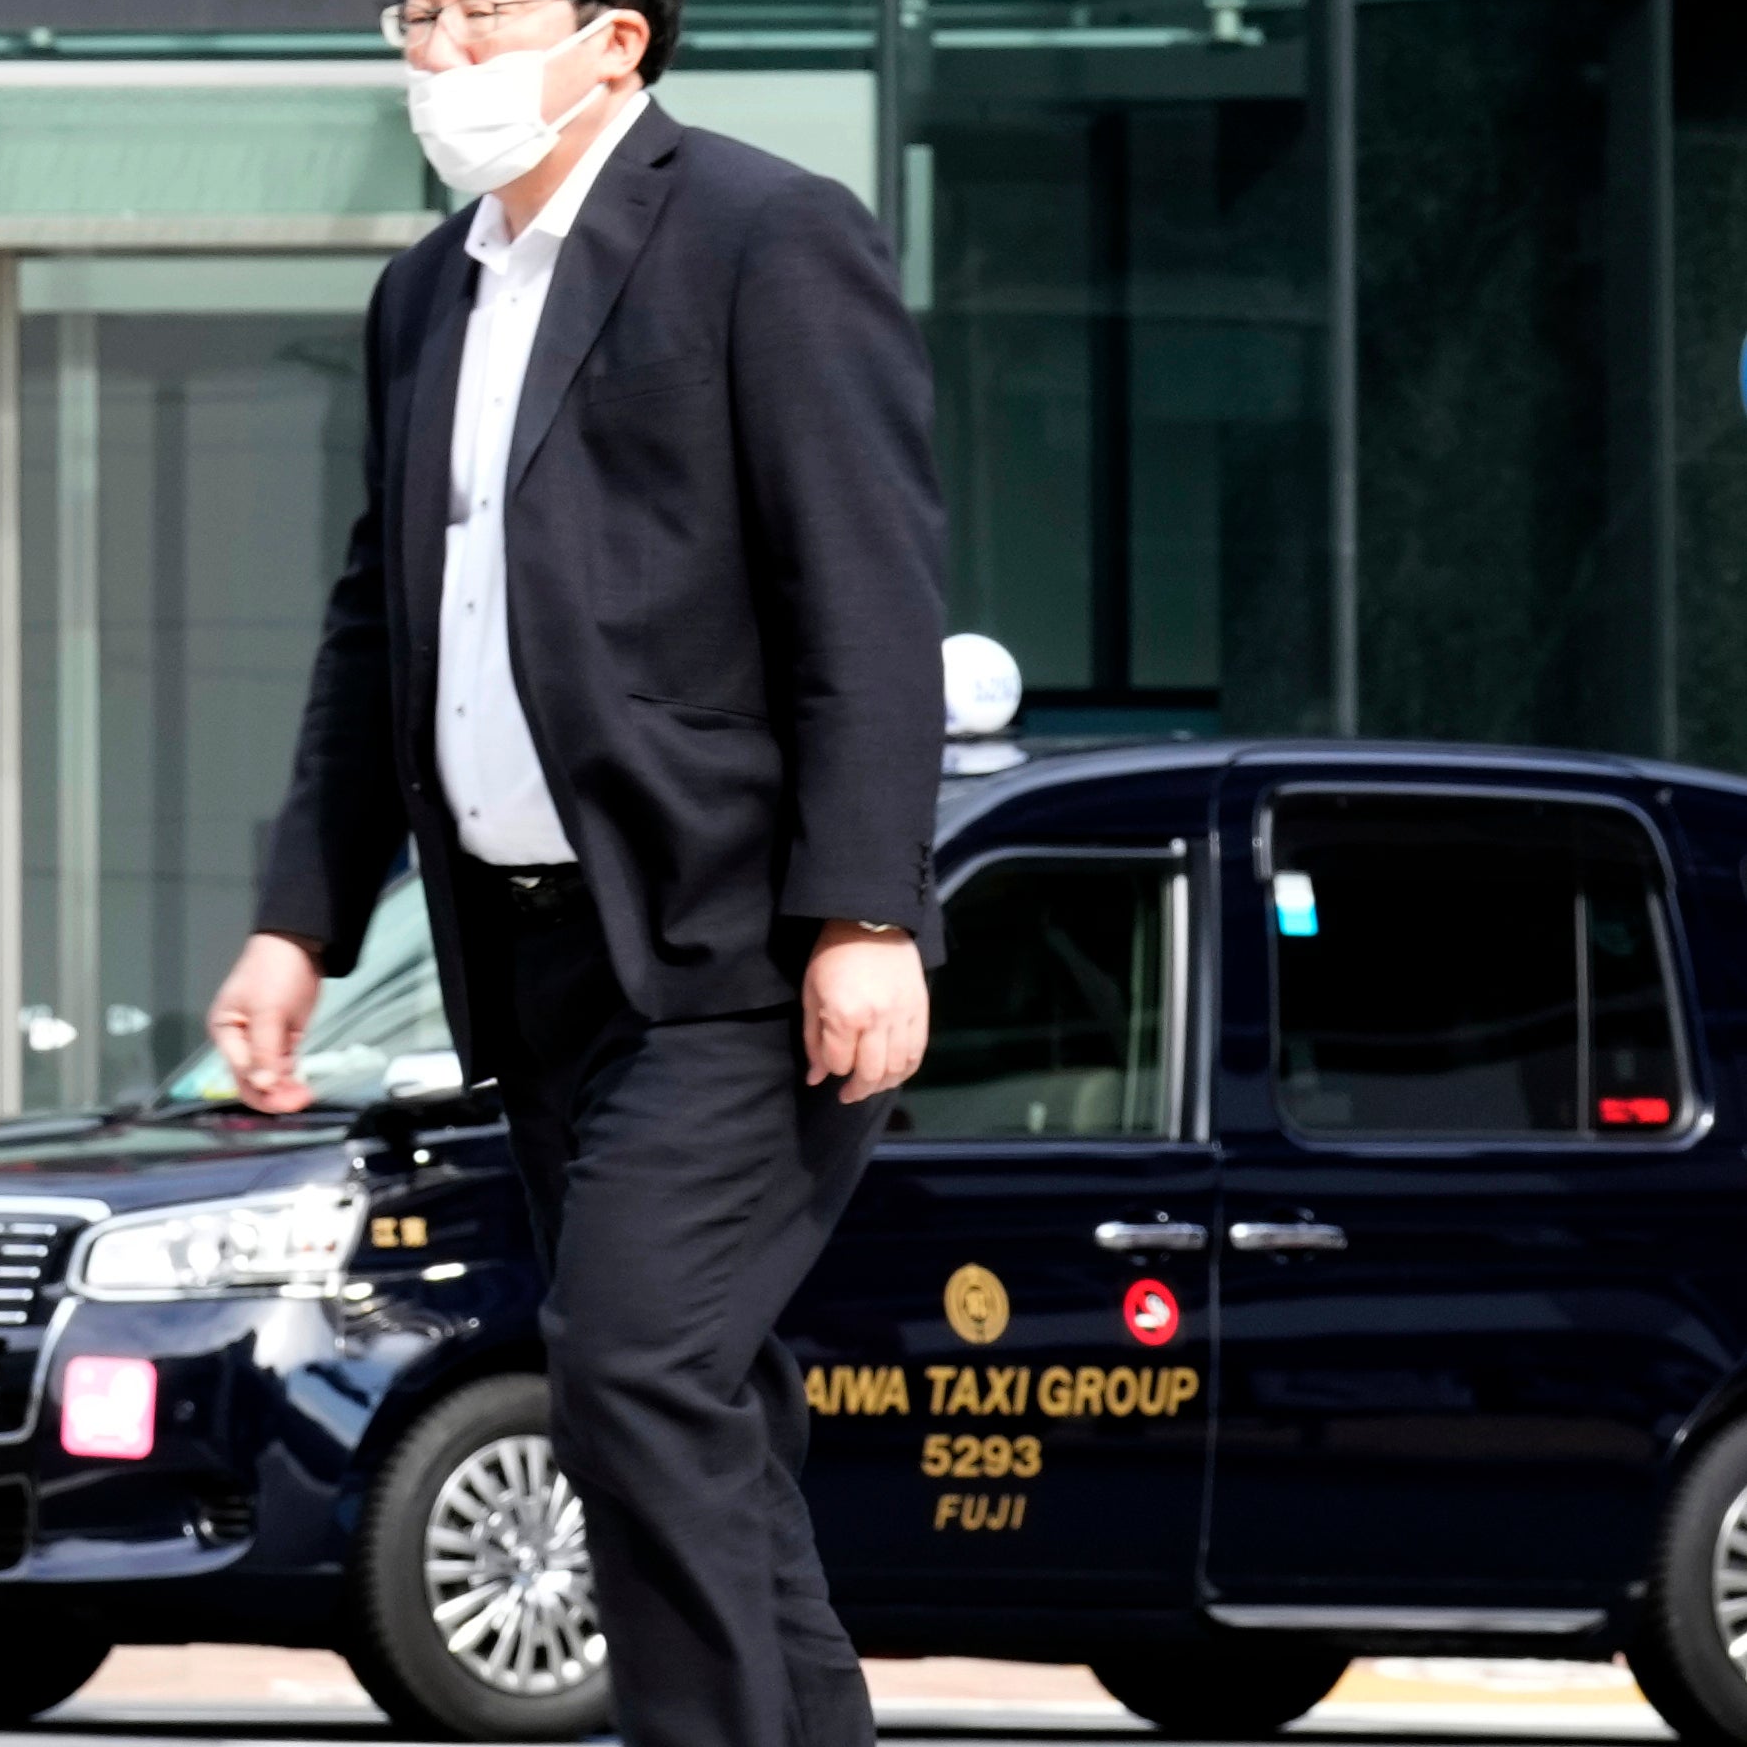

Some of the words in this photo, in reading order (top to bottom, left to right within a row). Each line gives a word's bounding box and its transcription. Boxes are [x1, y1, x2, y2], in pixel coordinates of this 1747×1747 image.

[804, 1365, 910, 1416] AIWA
[924, 1365, 1030, 1416] TAXI
[1036, 1365, 1199, 1417] GROUP
[920, 1435, 1043, 1478] 5293
[933, 1494, 1027, 1532] FUJI
